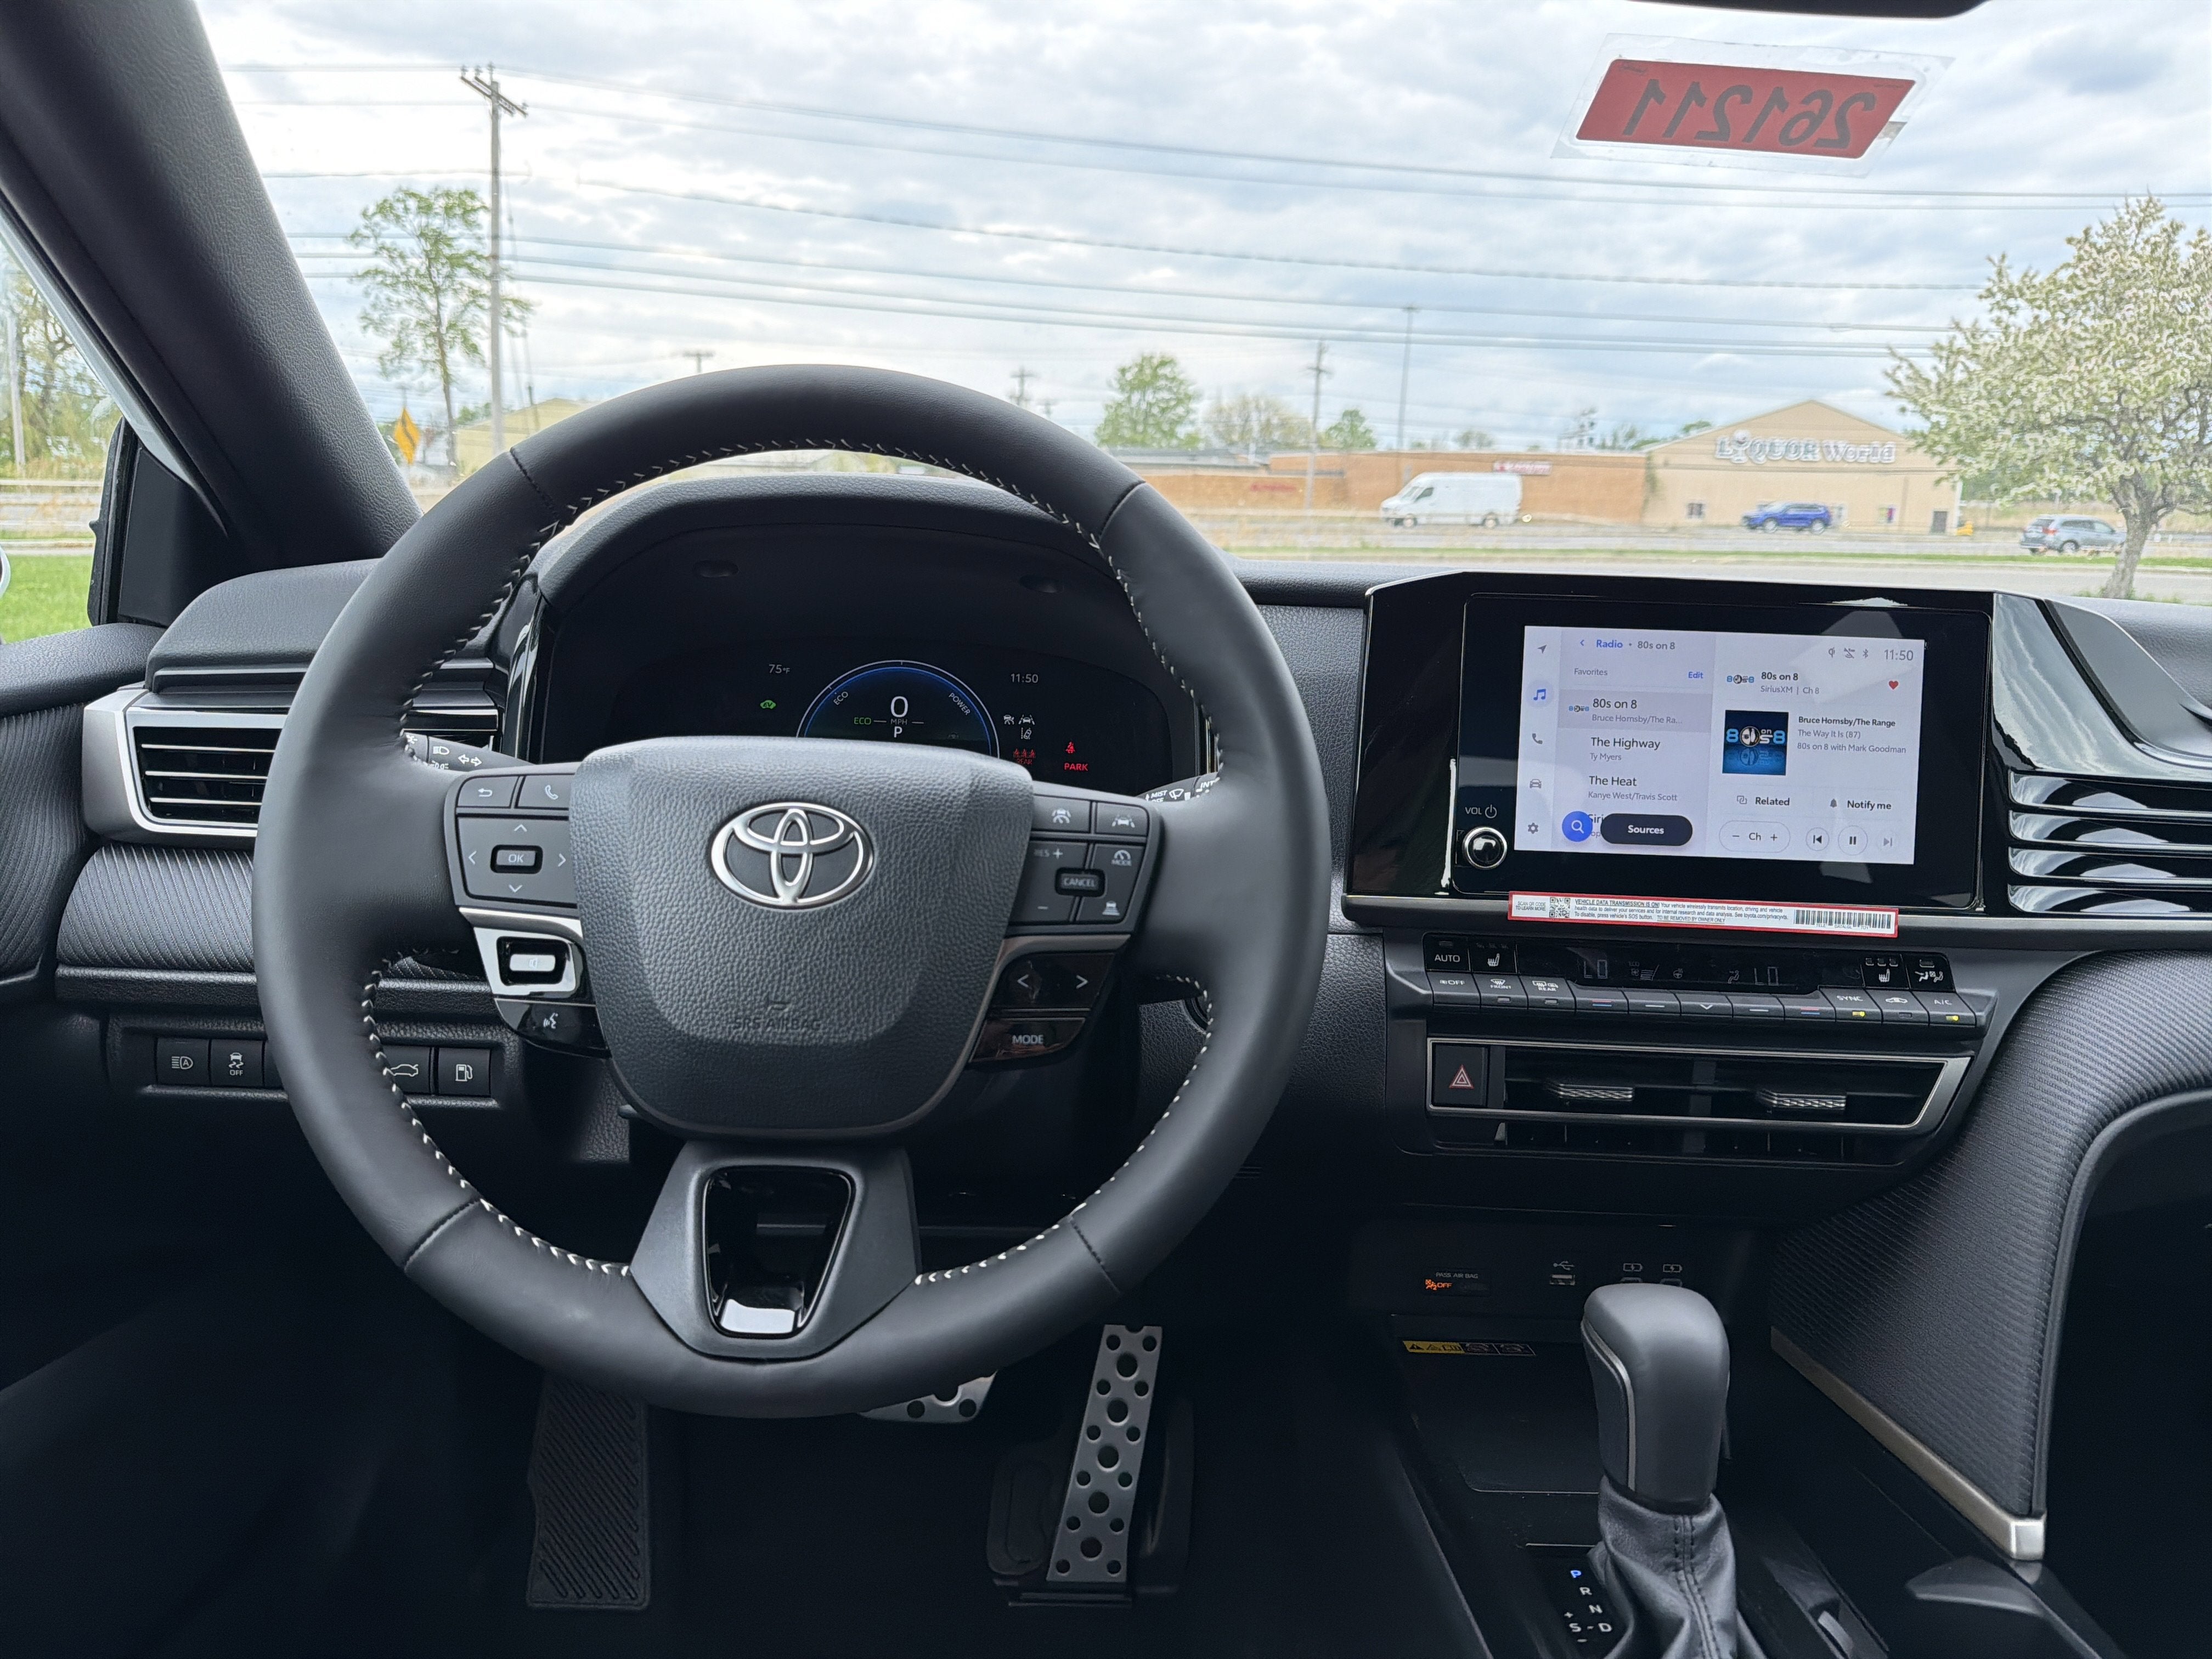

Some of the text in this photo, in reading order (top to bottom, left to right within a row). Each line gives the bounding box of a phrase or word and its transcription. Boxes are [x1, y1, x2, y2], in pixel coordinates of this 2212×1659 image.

[1596, 640, 1623, 648] Radio
[1637, 641, 1654, 650] 80s
[1669, 642, 1675, 650] 8
[1884, 650, 1914, 661] 11:50
[1574, 668, 1608, 676] Favorites
[1761, 672, 1778, 681] 80s
[1793, 673, 1798, 681] 8
[1011, 674, 1039, 684] 11:50
[833, 691, 849, 706] ECO
[890, 696, 909, 718] 0
[949, 692, 970, 715] POWER
[1593, 698, 1611, 709] 80s
[1614, 701, 1628, 709] on
[1630, 699, 1638, 709] 8
[1615, 715, 1664, 724] Hornsby/The
[1821, 718, 1870, 727] Hornsby/The
[1872, 719, 1896, 727] Range
[894, 726, 903, 738] P
[1813, 730, 1830, 739] Way
[1846, 731, 1861, 740] (87)
[1591, 737, 1661, 751] The Highway
[1868, 745, 1906, 753] Goodman
[1590, 753, 1598, 761] Ty
[1064, 763, 1088, 771] PARK
[1589, 776, 1637, 787] The Heat
[1150, 790, 1168, 799] MIST
[1588, 791, 1678, 801] Kanye West/Travis Scott
[1755, 797, 1790, 806] Related
[1847, 800, 1875, 811] Notify
[1628, 826, 1664, 834] Sources
[1748, 832, 1762, 841] Ch
[508, 854, 524, 864] OK
[1063, 878, 1095, 887] CANCEL
[1434, 954, 1460, 962] AUTO
[1012, 1035, 1044, 1044] MODE
[1570, 1570, 1582, 1578] P
[1579, 1587, 1592, 1595] R
[1589, 1604, 1602, 1613] N
[1569, 1623, 1612, 1632] S D
